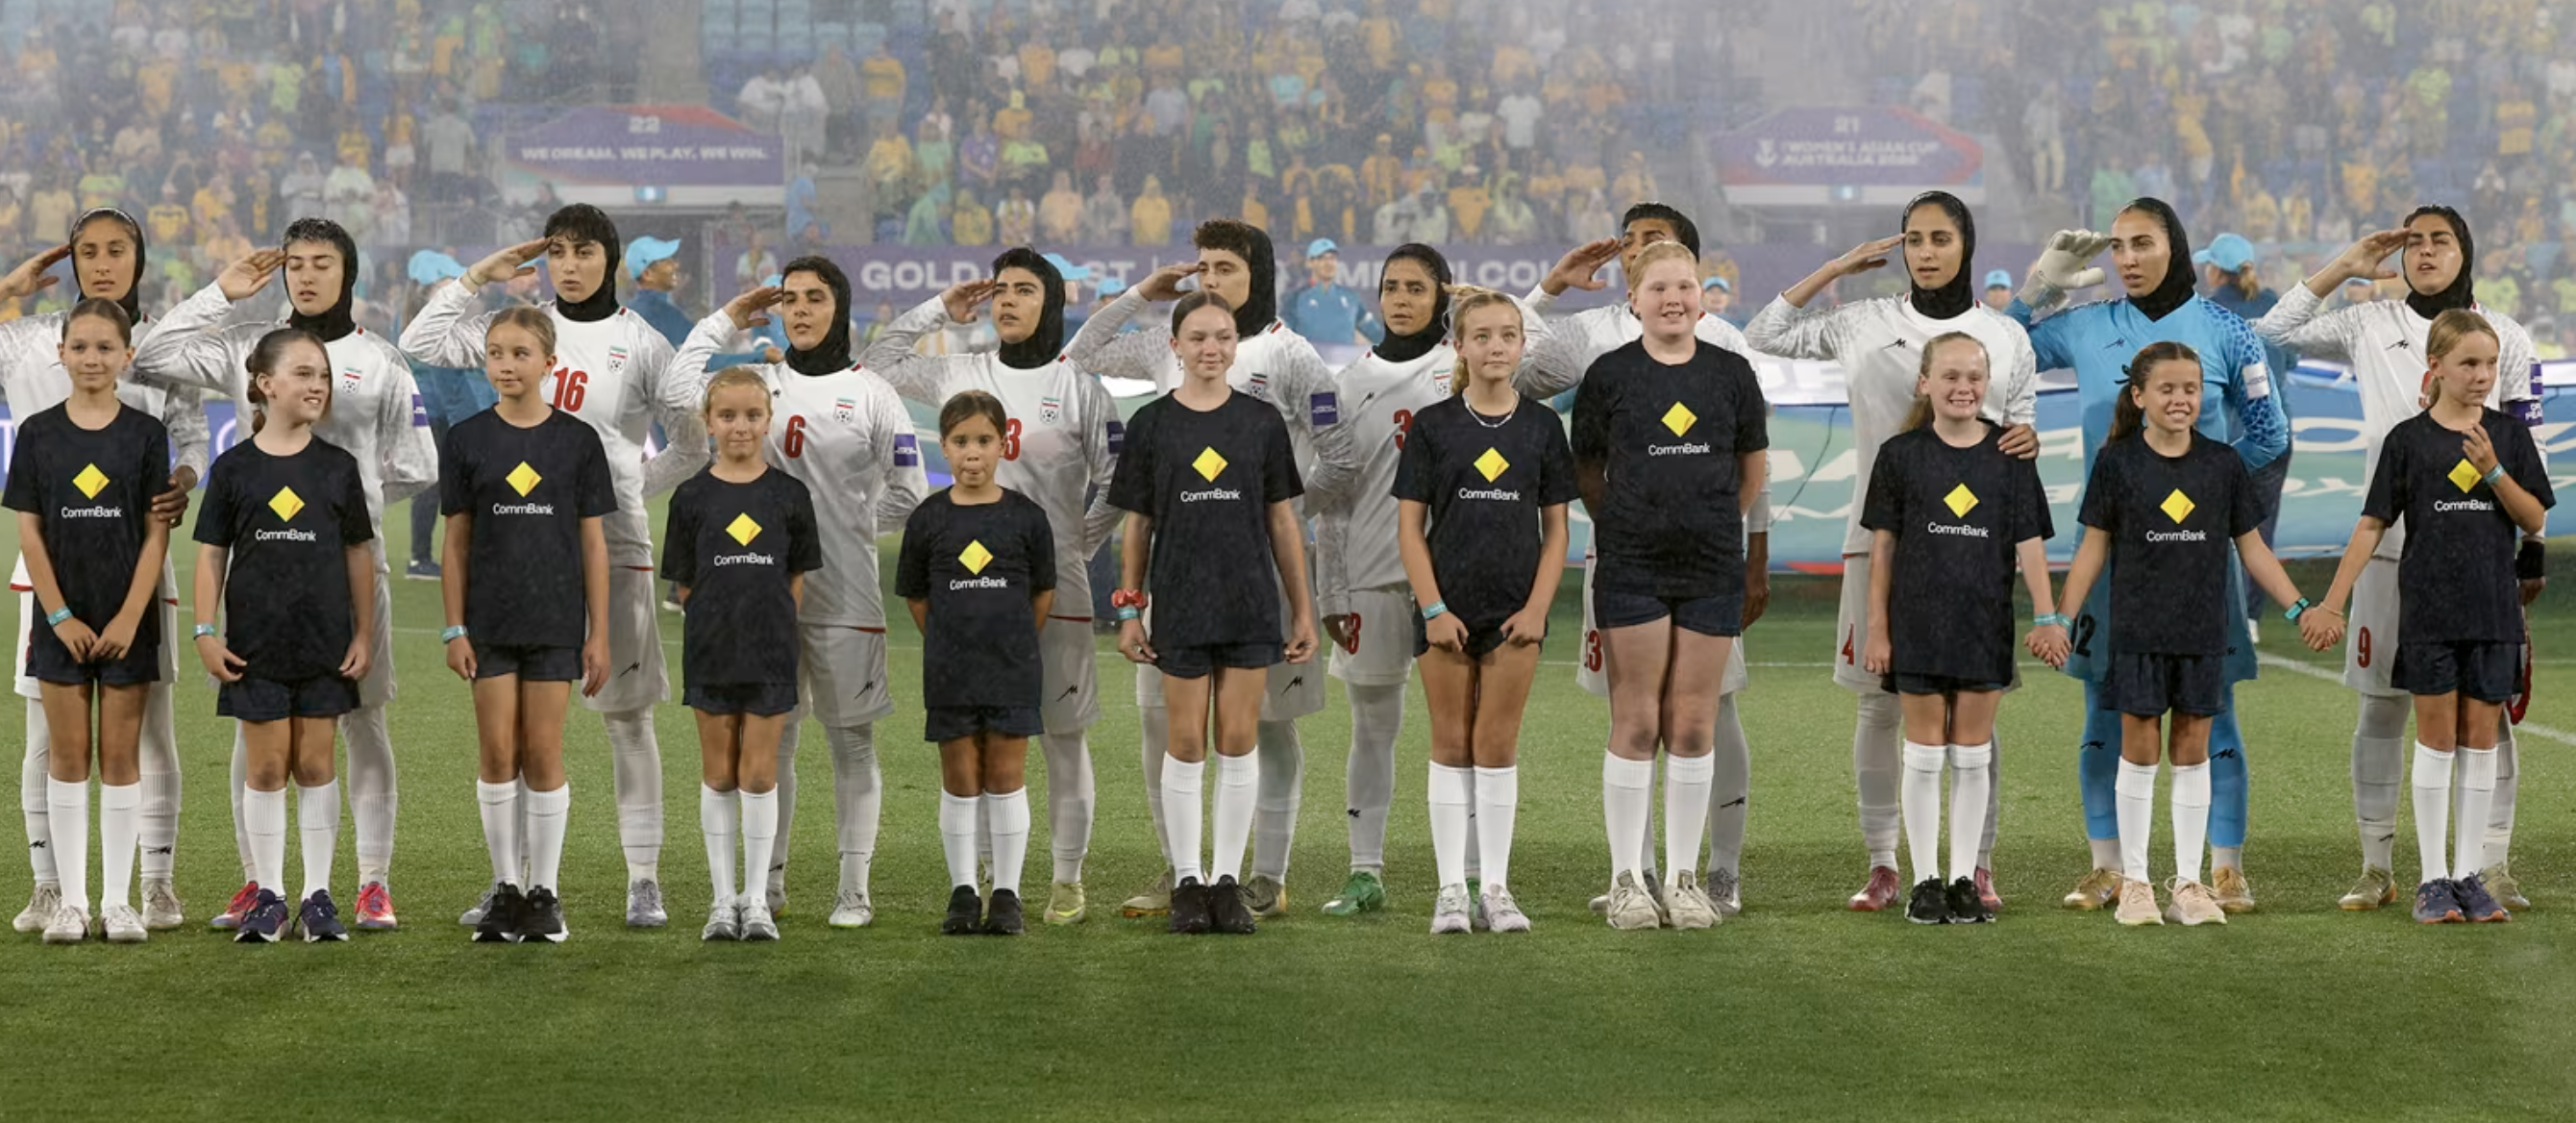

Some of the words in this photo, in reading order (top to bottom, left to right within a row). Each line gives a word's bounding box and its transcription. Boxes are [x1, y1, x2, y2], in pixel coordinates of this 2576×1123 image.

[628, 115, 661, 135] 22
[520, 147, 549, 161] WE
[620, 147, 648, 161] WE
[699, 147, 728, 161] WE
[860, 260, 981, 291] GOLD
[553, 366, 589, 412] 16
[784, 414, 806, 459] 6
[1647, 442, 1711, 457] CommBank
[1179, 488, 1241, 503] CommBank
[1458, 487, 1521, 501] CommBank
[61, 506, 122, 519] CommBank
[492, 503, 555, 515] CommBank
[255, 528, 317, 542] CommBank
[1927, 521, 1990, 538] CommBank
[2145, 529, 2207, 542] CommBank
[713, 553, 775, 567] CommBank
[949, 577, 1008, 591] CommBank
[1841, 624, 1855, 665] 4
[2357, 626, 2371, 667] 9
